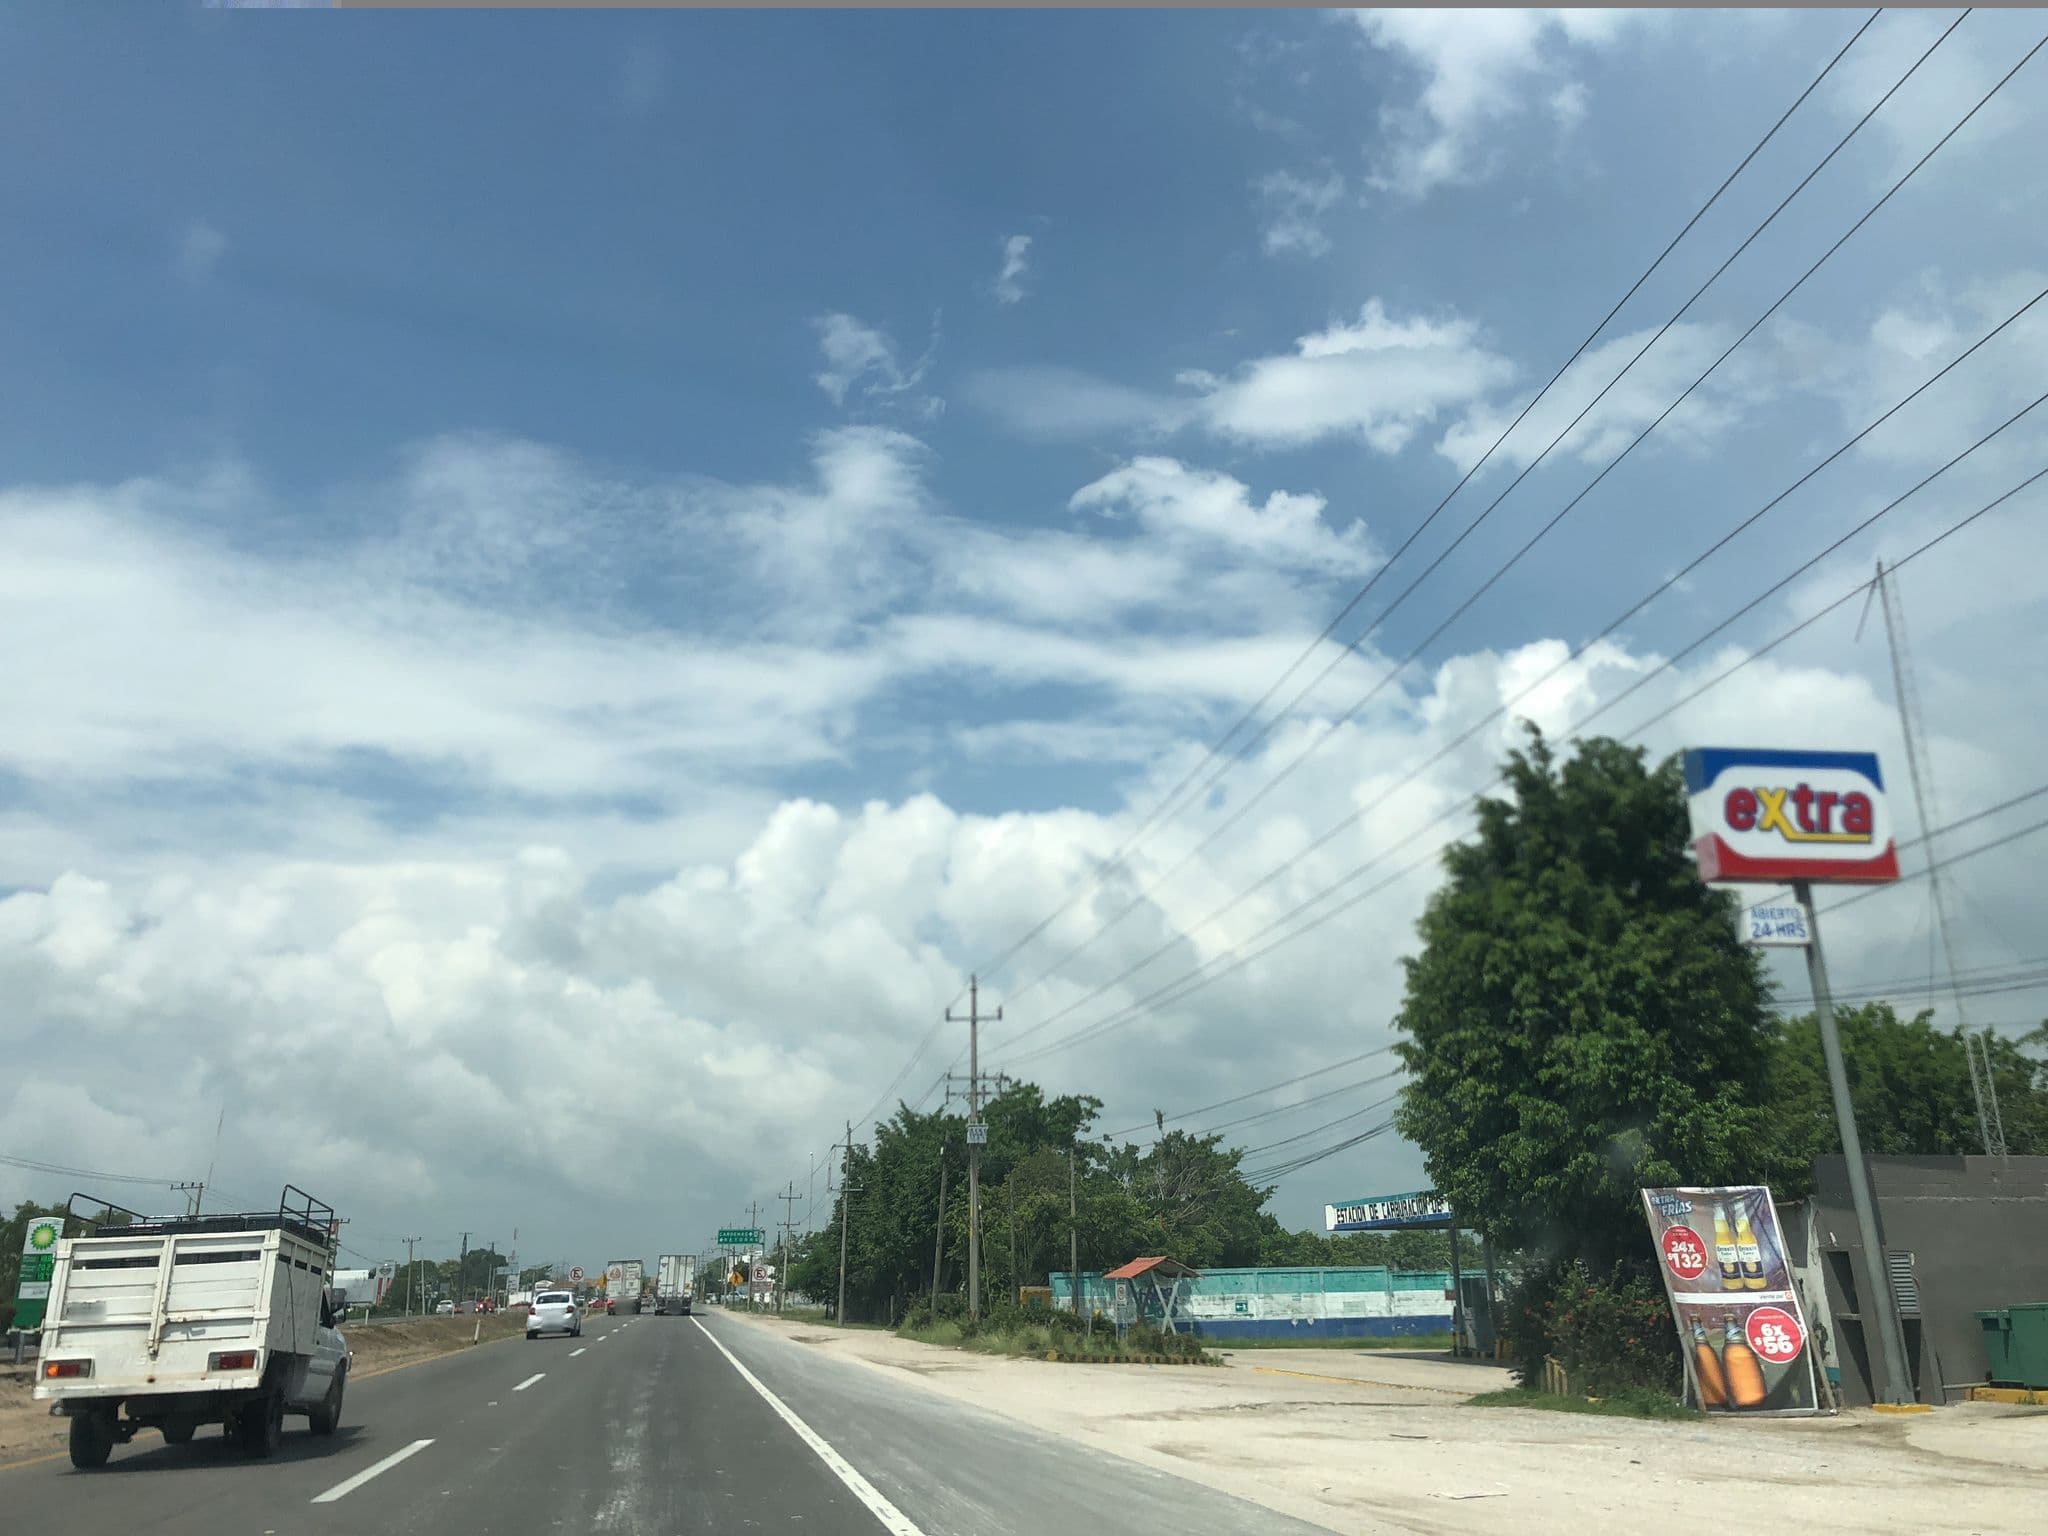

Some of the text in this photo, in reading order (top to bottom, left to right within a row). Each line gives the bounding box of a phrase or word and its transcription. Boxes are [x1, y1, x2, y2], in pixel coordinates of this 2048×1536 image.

[1724, 782, 1874, 844] extra
[1751, 921, 1772, 938] 24
[1336, 1205, 1367, 1224] ESTACION
[1368, 1202, 1379, 1220] DE
[1671, 1240, 1696, 1253] 24x
[1667, 1252, 1703, 1269] $132
[1761, 1323, 1785, 1337] 6x
[1753, 1334, 1794, 1355] $56
